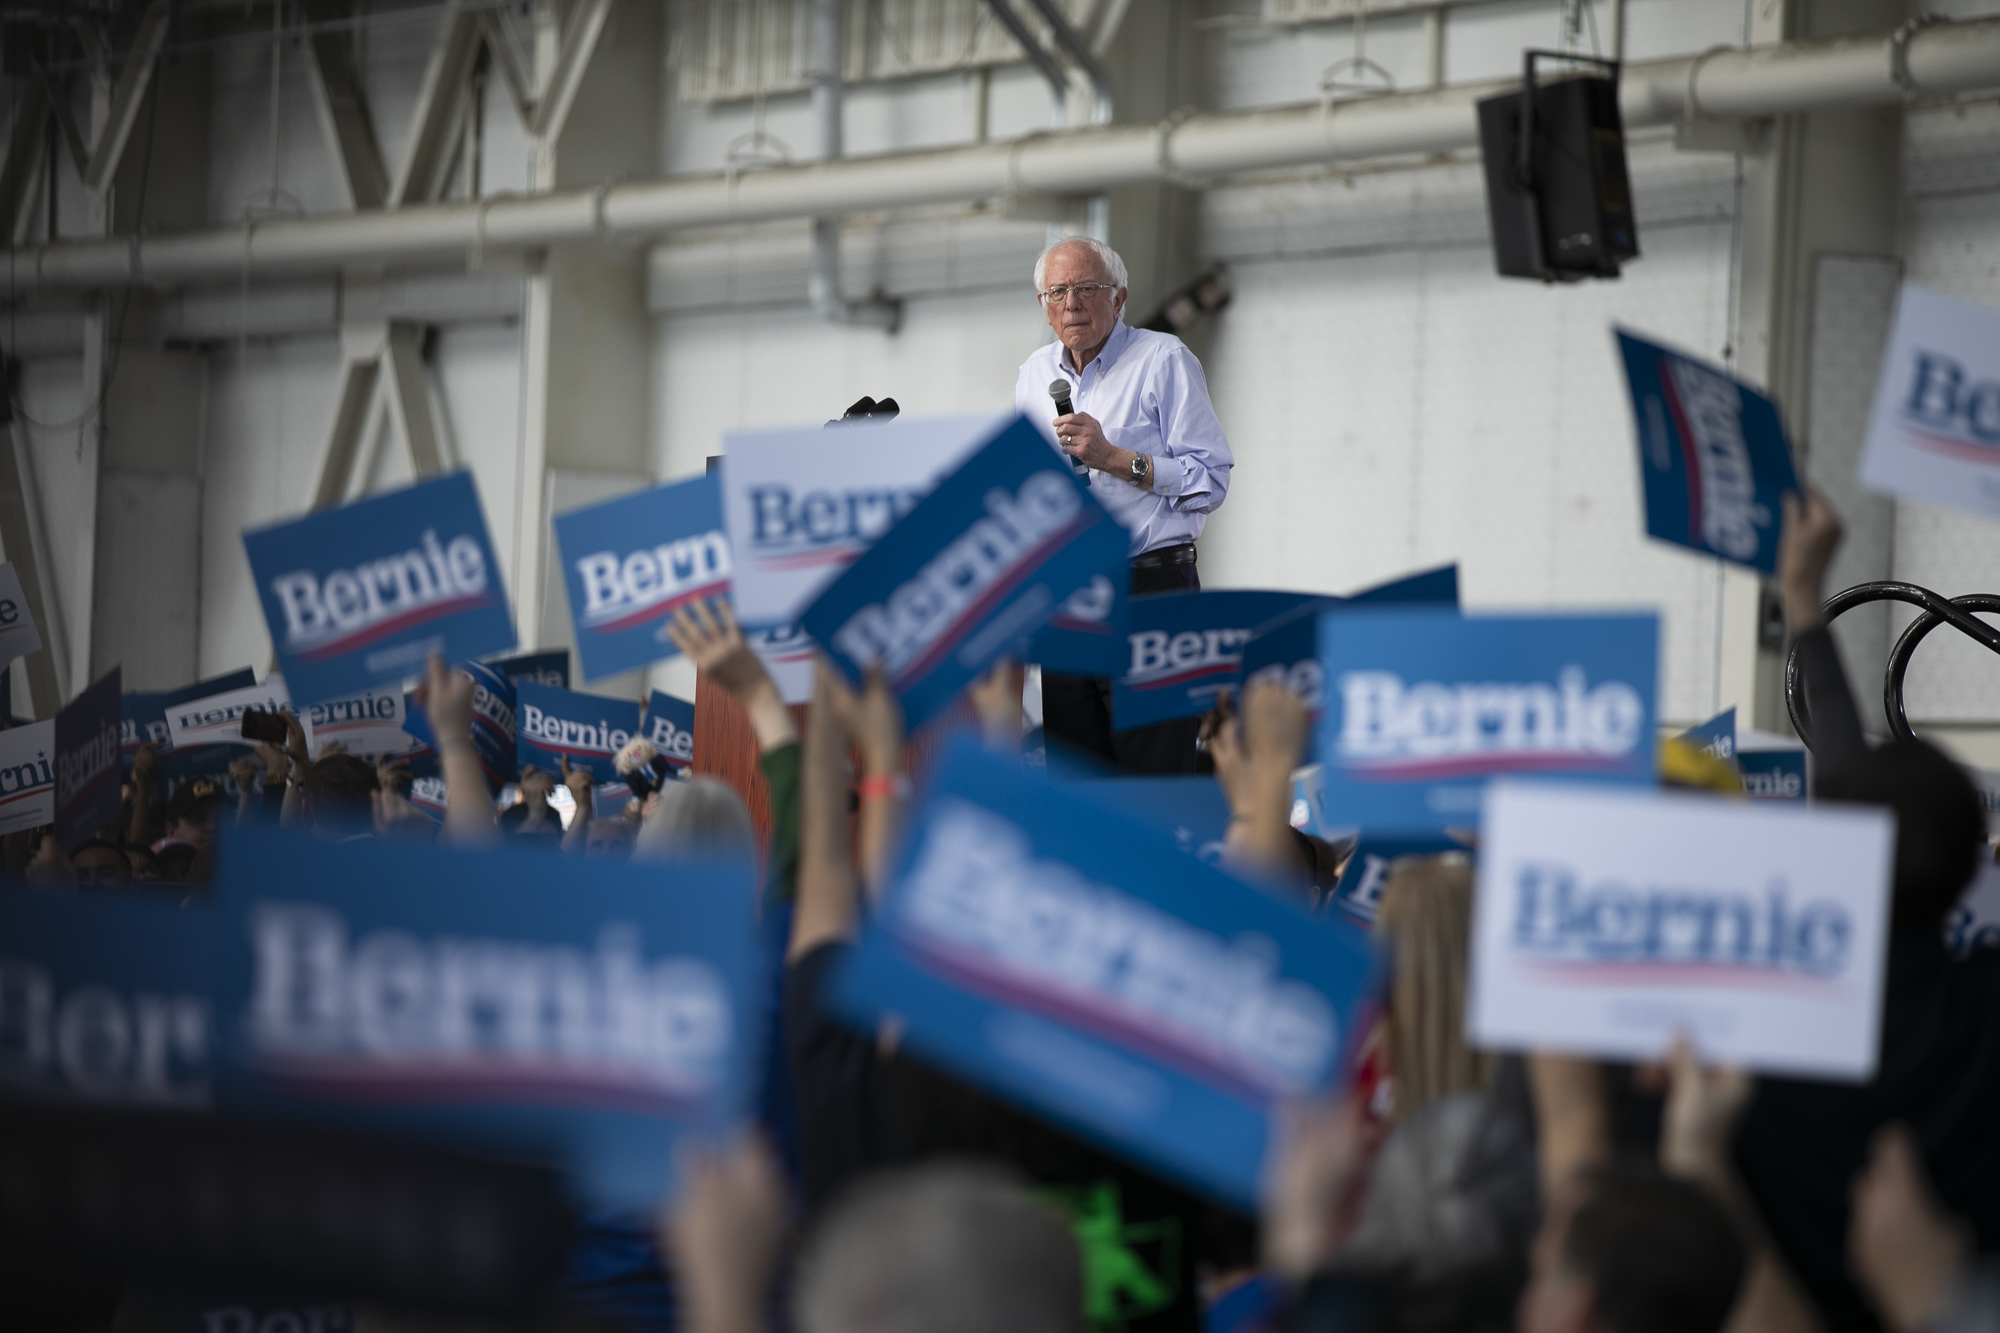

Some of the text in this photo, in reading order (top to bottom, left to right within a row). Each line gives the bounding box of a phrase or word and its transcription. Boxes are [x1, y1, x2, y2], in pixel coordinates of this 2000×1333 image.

[1674, 356, 1772, 560] Bernie
[748, 484, 910, 545] Ber
[271, 526, 491, 645] Bernie
[577, 530, 732, 611] Bern
[831, 469, 1083, 675] Bernie
[1127, 629, 1250, 675] Ber
[524, 703, 631, 751] Bernie
[1339, 667, 1643, 757] Bernie
[0, 750, 55, 797] rni
[58, 717, 118, 800] Bernie
[1741, 767, 1800, 797] rnie
[900, 799, 1336, 1092] Bernie
[1513, 862, 1852, 978] Bernie
[249, 901, 733, 1083] Bernie
